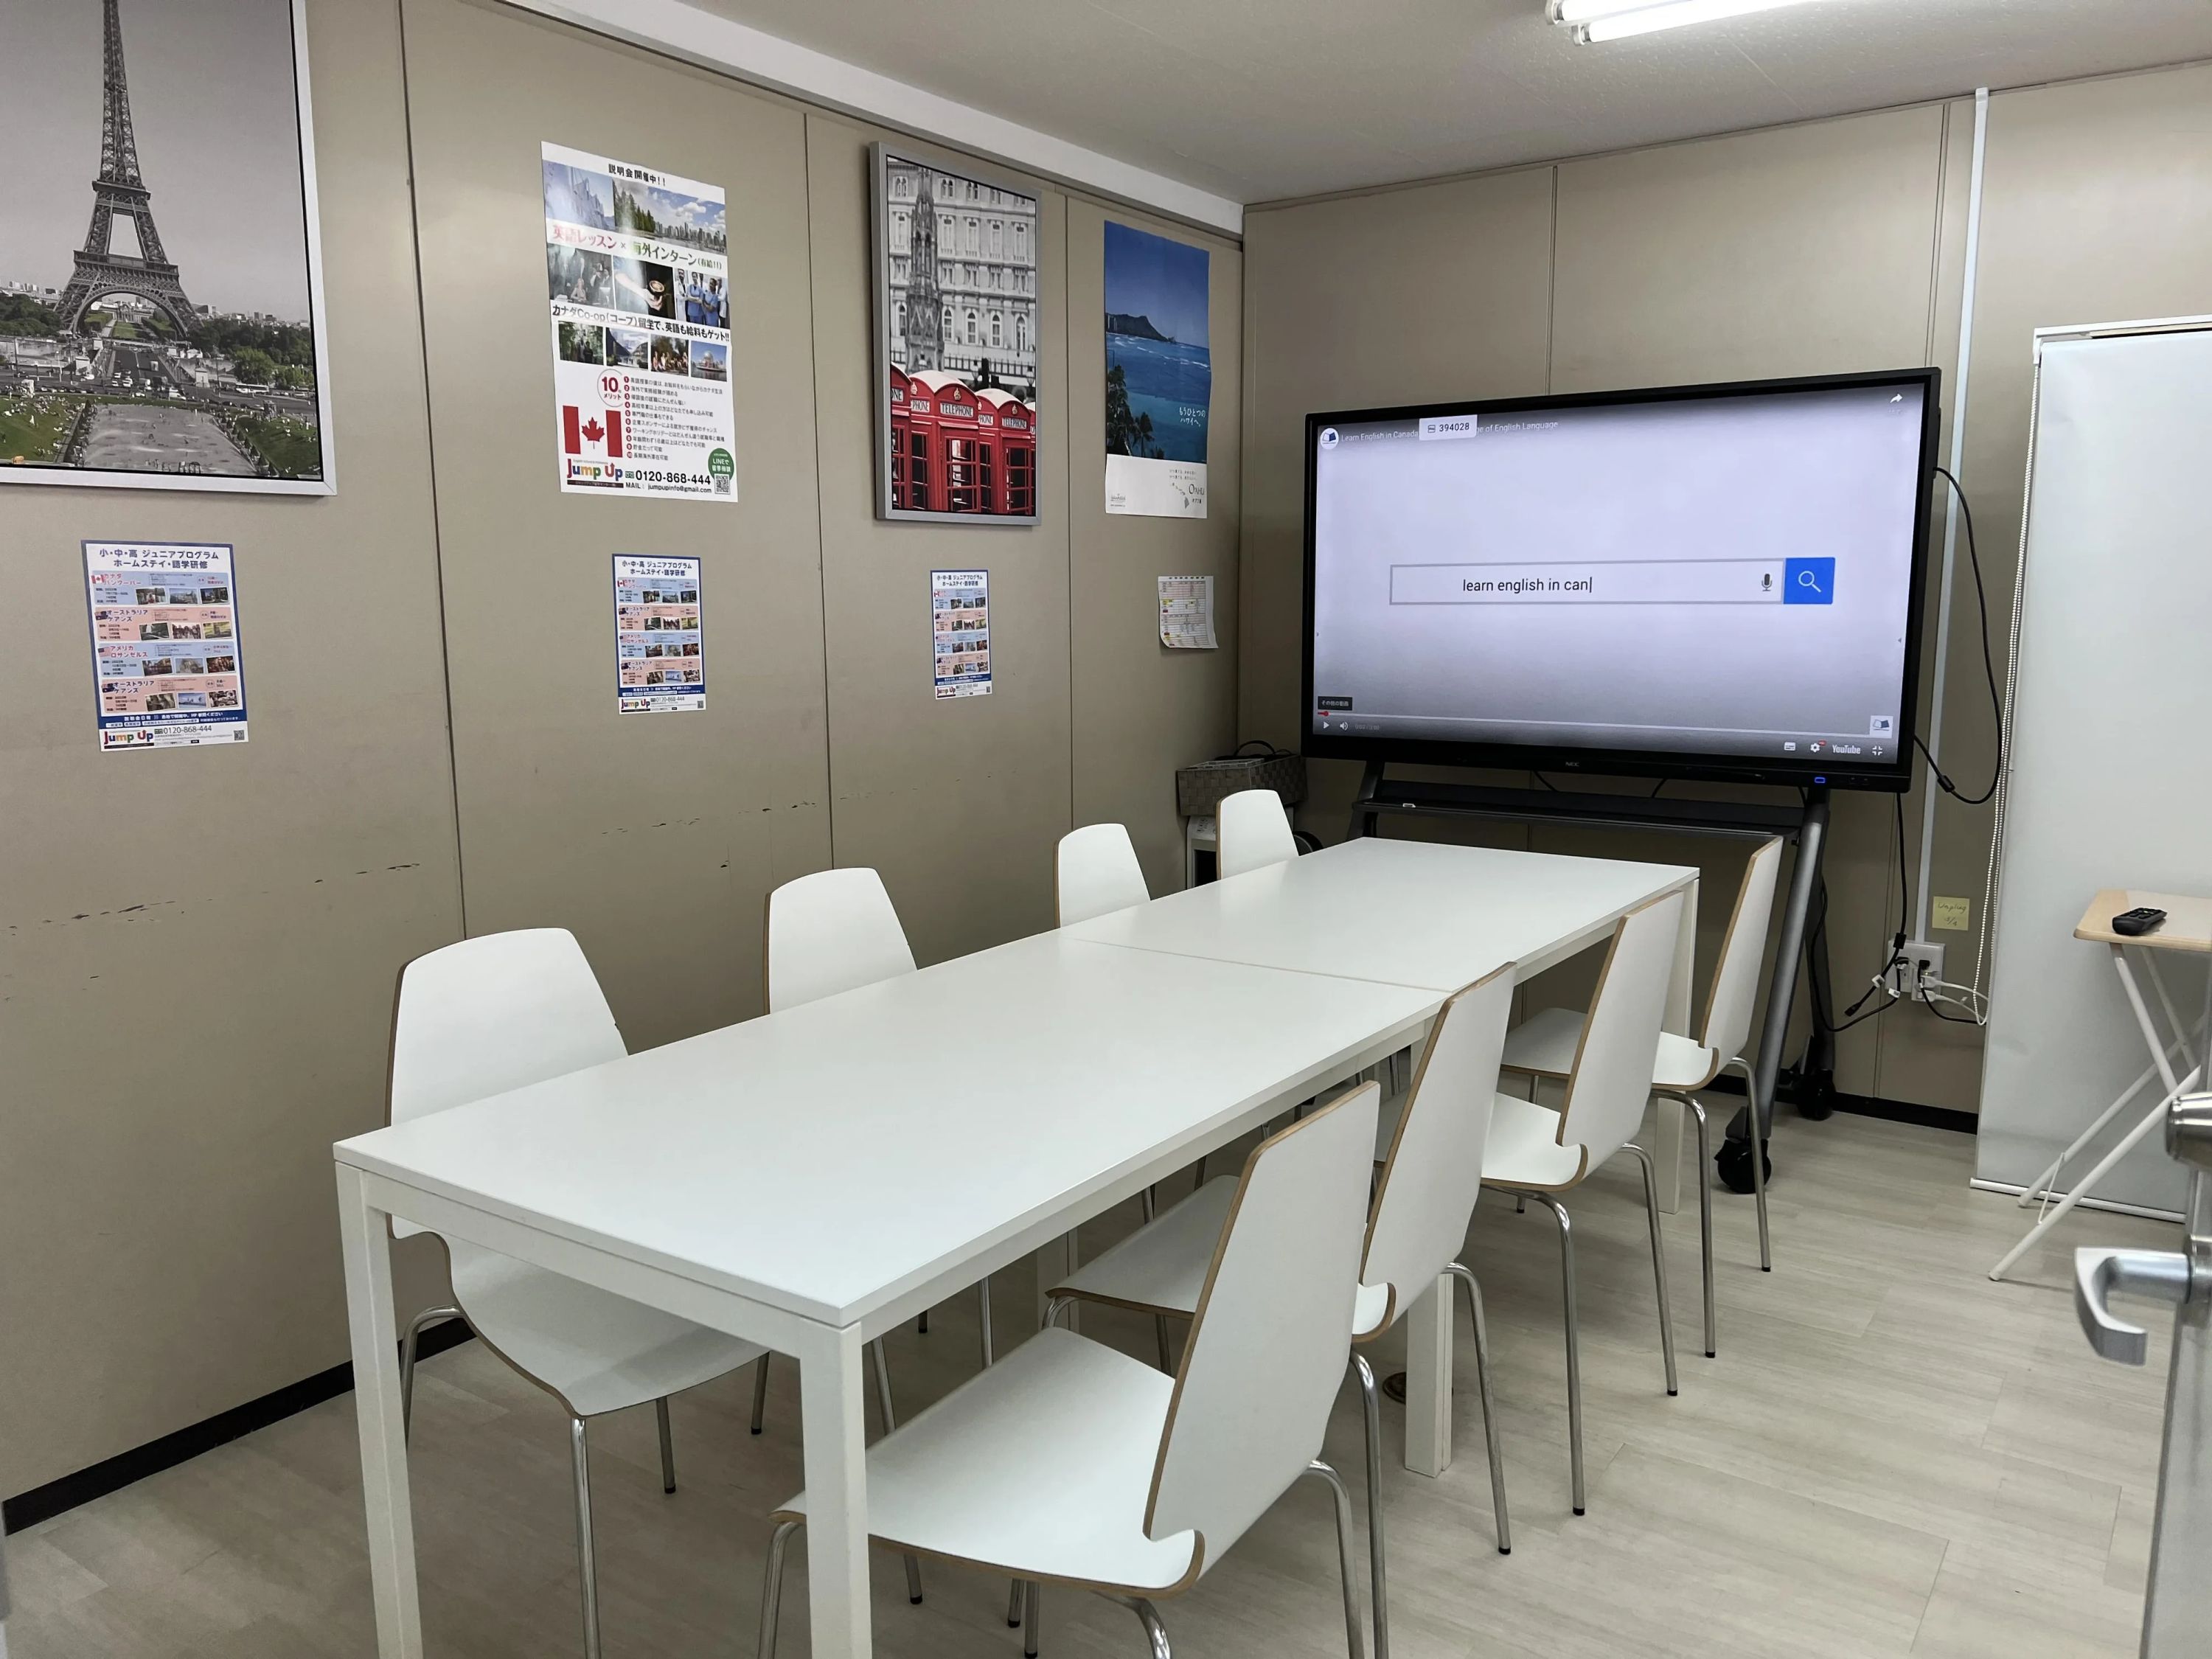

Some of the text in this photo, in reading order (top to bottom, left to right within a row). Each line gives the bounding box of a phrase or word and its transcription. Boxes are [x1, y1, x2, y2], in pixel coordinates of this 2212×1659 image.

[942, 403, 973, 417] TELEPHONE
[1179, 406, 1206, 417] もうひとつの
[1003, 418, 1026, 428] TELEPHONE
[1439, 422, 1470, 432] 394028
[1341, 434, 1359, 442] Learn
[1360, 432, 1385, 441] English
[1385, 431, 1392, 439] in
[1393, 430, 1419, 439] Canada
[1494, 423, 1520, 432] English
[1522, 421, 1558, 431] Language
[567, 458, 623, 481] Jump Up
[636, 470, 711, 485] 0120-868-444
[647, 484, 712, 493] jumpupinfo@gmail.com
[100, 549, 219, 560] 小・中・高 ジュニアプログラム
[114, 560, 208, 568] ホームステイ・語学研修
[647, 560, 692, 568] ジュニアプログラム
[1463, 579, 1494, 591] learn
[1498, 578, 1544, 594] english
[1548, 578, 1559, 591] in
[621, 698, 639, 709] Jump
[641, 698, 650, 708] Up
[163, 726, 212, 734] 0120-868-444
[104, 731, 134, 745] Jump
[137, 729, 153, 742] Up
[1832, 744, 1861, 754] YouTube
